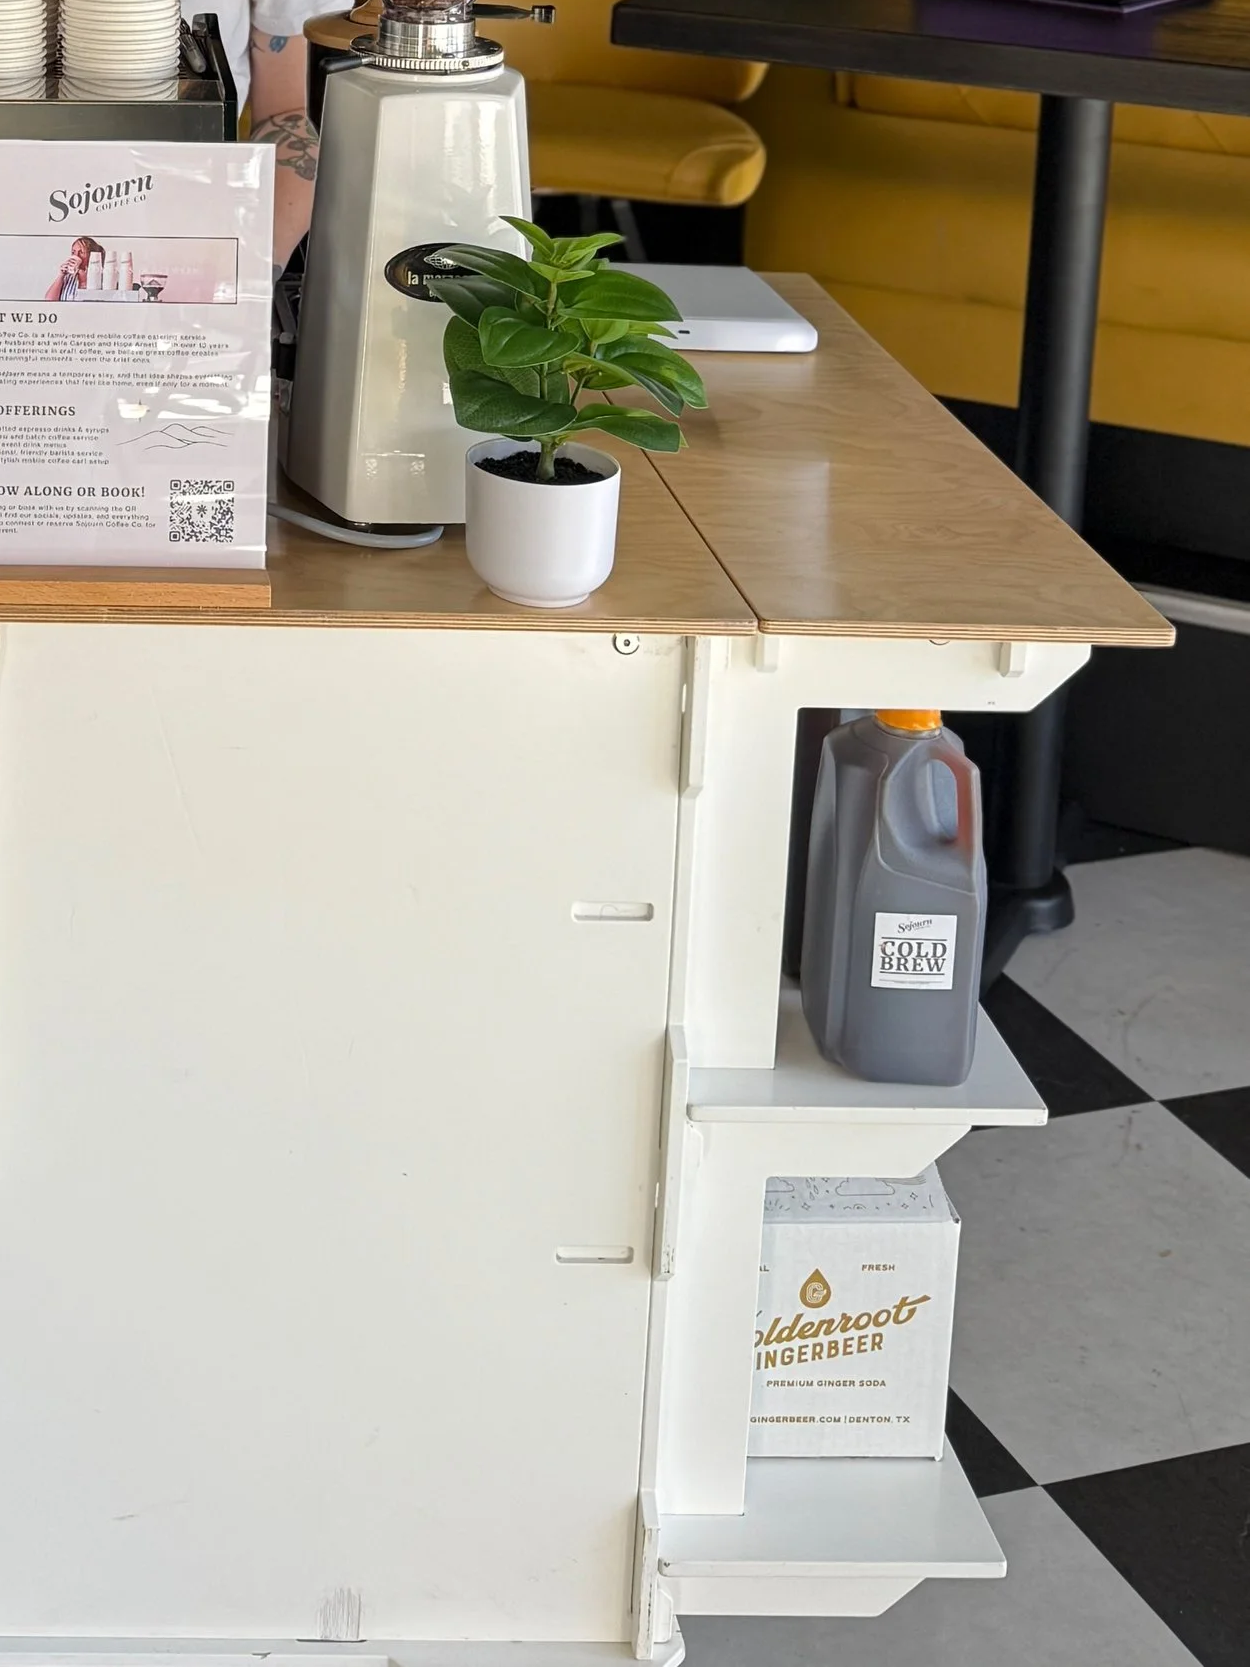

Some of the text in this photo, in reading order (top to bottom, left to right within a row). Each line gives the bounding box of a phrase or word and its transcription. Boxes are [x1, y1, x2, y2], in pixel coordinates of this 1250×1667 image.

[48, 173, 154, 223] Sojourn
[407, 270, 419, 285] la
[11, 312, 33, 323] WE
[38, 312, 58, 324] DO
[24, 485, 73, 497] ALONG
[77, 486, 97, 497] OR
[101, 486, 146, 498] BOOK!
[897, 918, 933, 934] Sojourn
[880, 940, 947, 959] COLD
[879, 955, 947, 972] BREW
[861, 1264, 896, 1272] FRESH
[754, 1294, 932, 1348] oldenroot
[755, 1332, 884, 1370] INGERBEER
[817, 1379, 855, 1387] GINGER
[858, 1379, 887, 1387] SODA
[849, 1415, 893, 1425] DENTON,
[895, 1415, 911, 1423] TX
